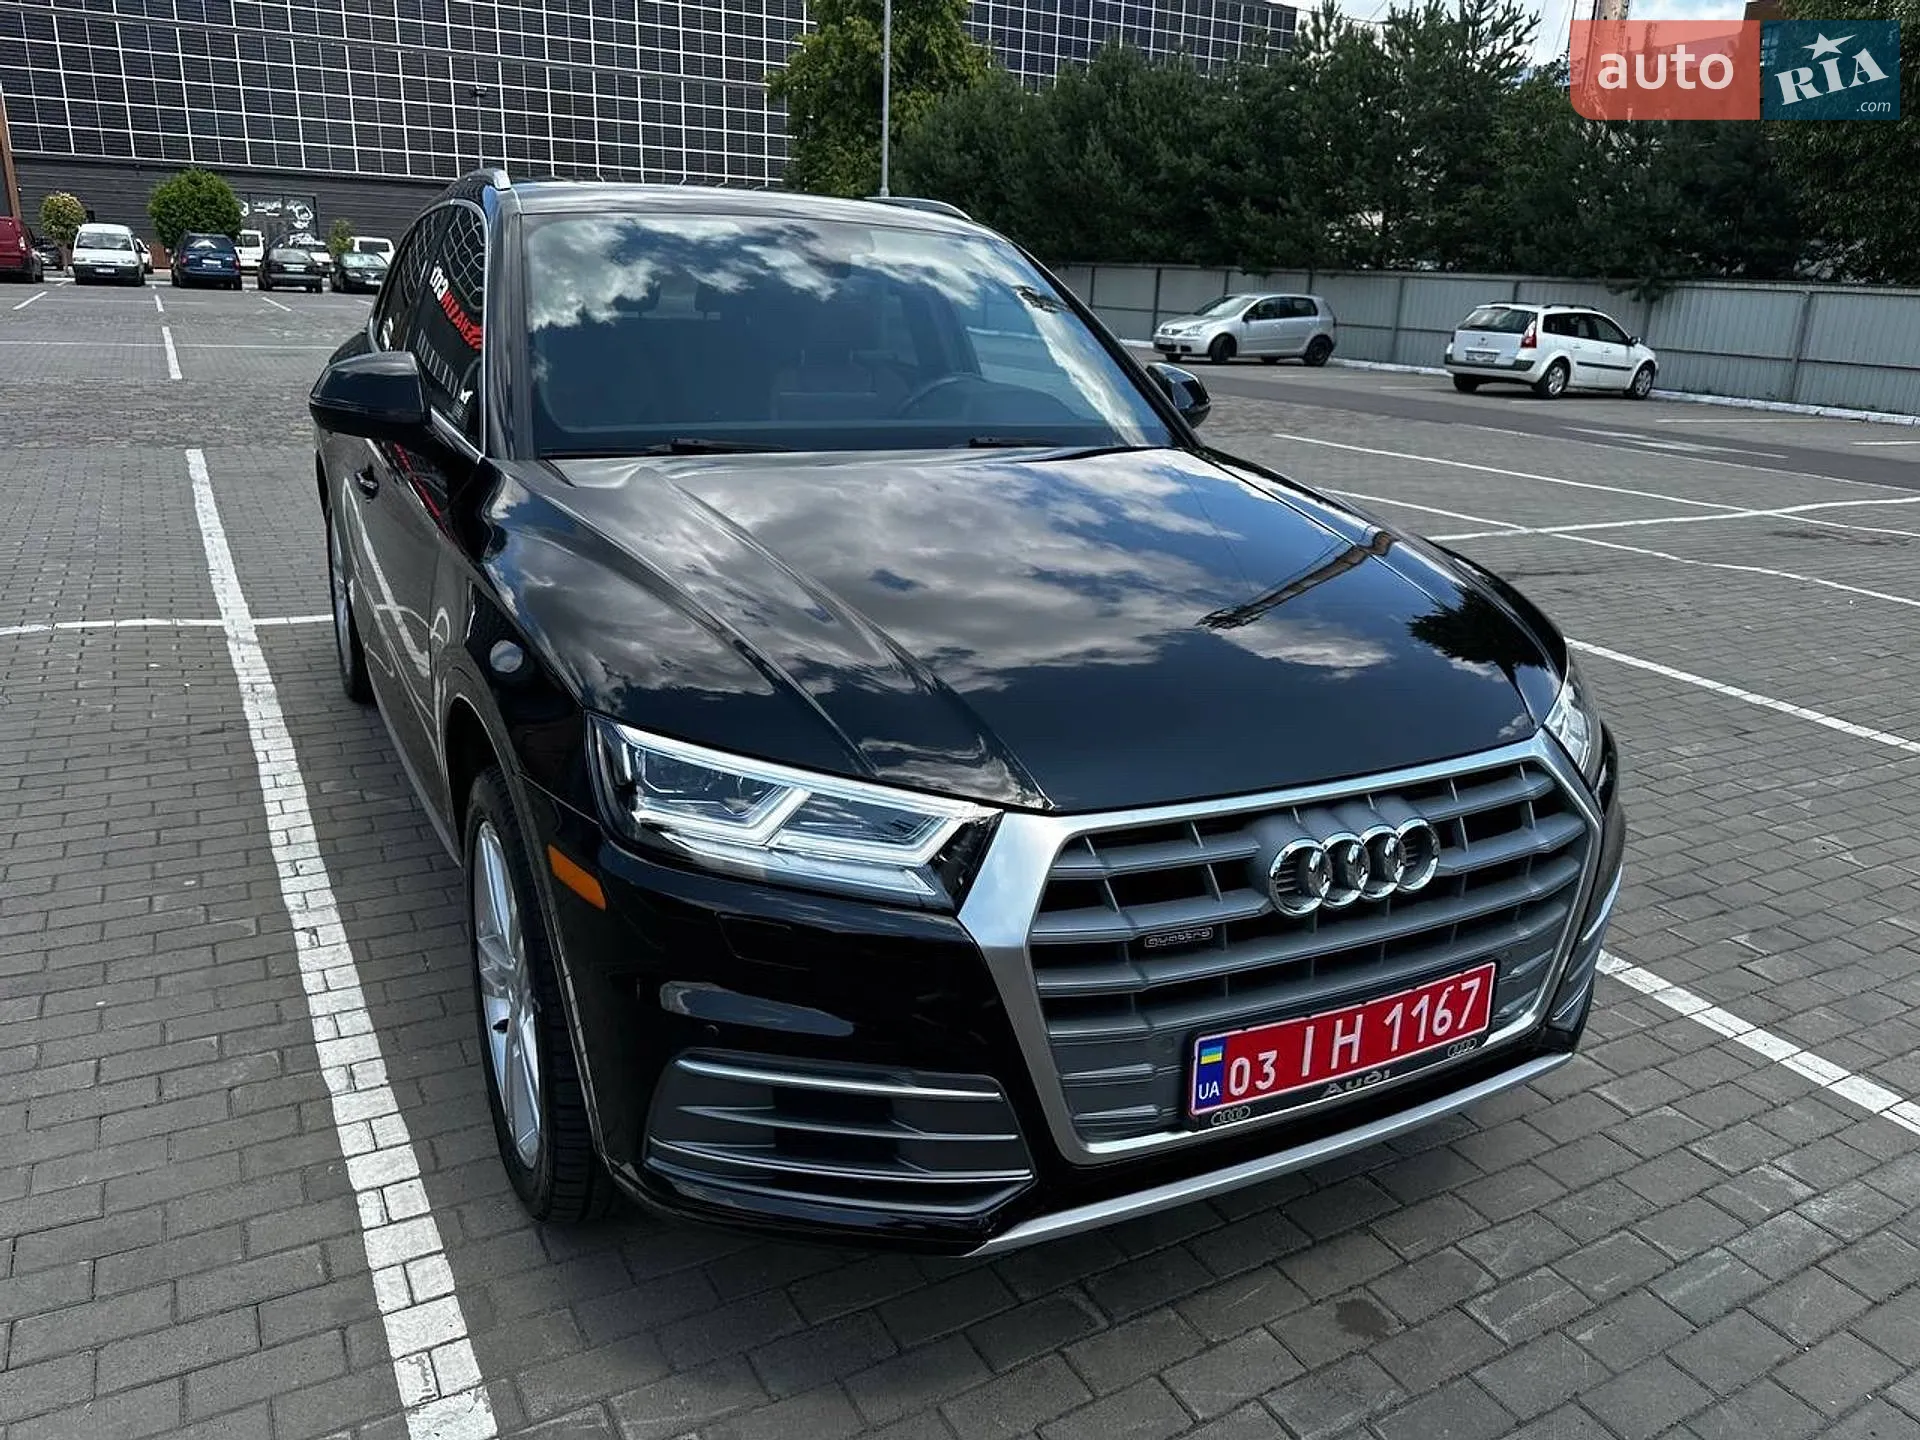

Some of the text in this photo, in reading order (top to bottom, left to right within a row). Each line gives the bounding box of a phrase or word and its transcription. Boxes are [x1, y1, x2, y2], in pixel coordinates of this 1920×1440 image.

[1229, 1049, 1278, 1097] 03
[1383, 978, 1481, 1053] 1167
[1198, 1080, 1221, 1100] UA
